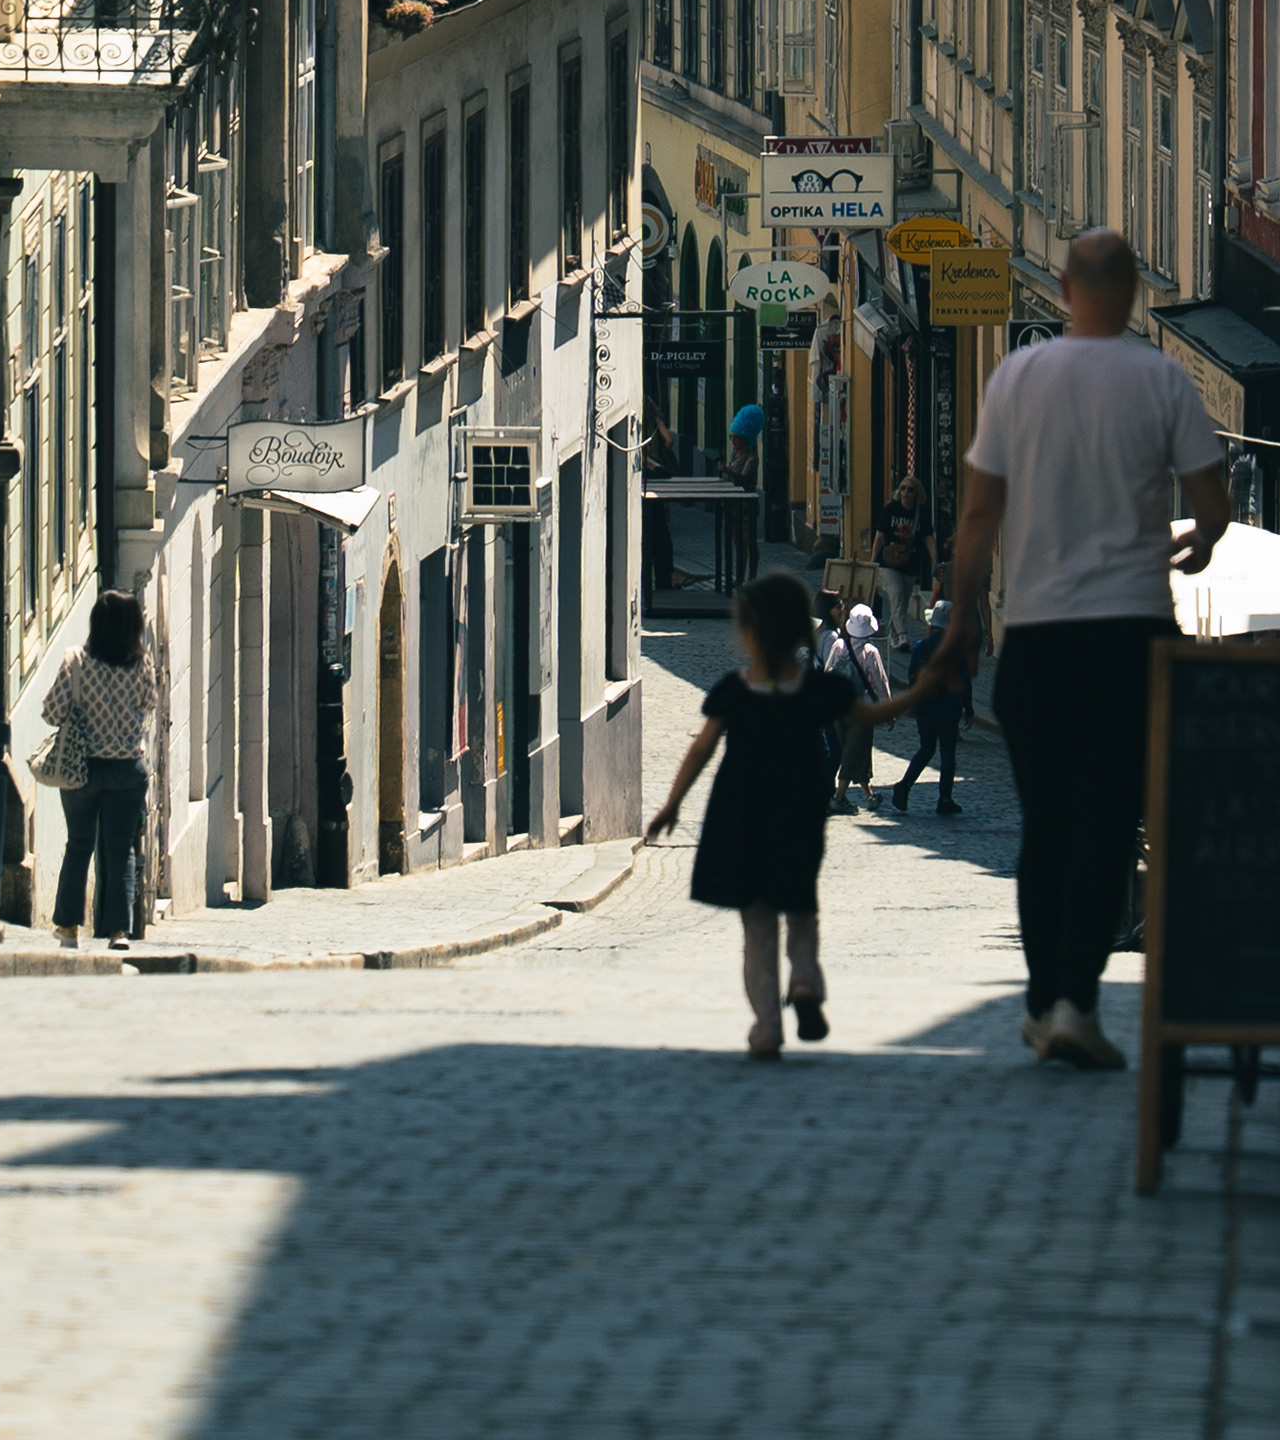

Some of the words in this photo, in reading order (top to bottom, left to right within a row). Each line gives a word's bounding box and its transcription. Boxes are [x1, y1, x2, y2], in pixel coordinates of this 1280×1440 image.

[770, 205, 824, 218] OPTIKA
[831, 202, 884, 218] HELA
[905, 232, 955, 250] Kredenca
[766, 270, 793, 285] LA
[941, 261, 1001, 285] Kredenca
[745, 283, 816, 303] ROCKA
[935, 307, 970, 316] TREATS
[972, 307, 978, 316] &
[981, 308, 1006, 316] WINE
[246, 430, 345, 486] Boudoir
